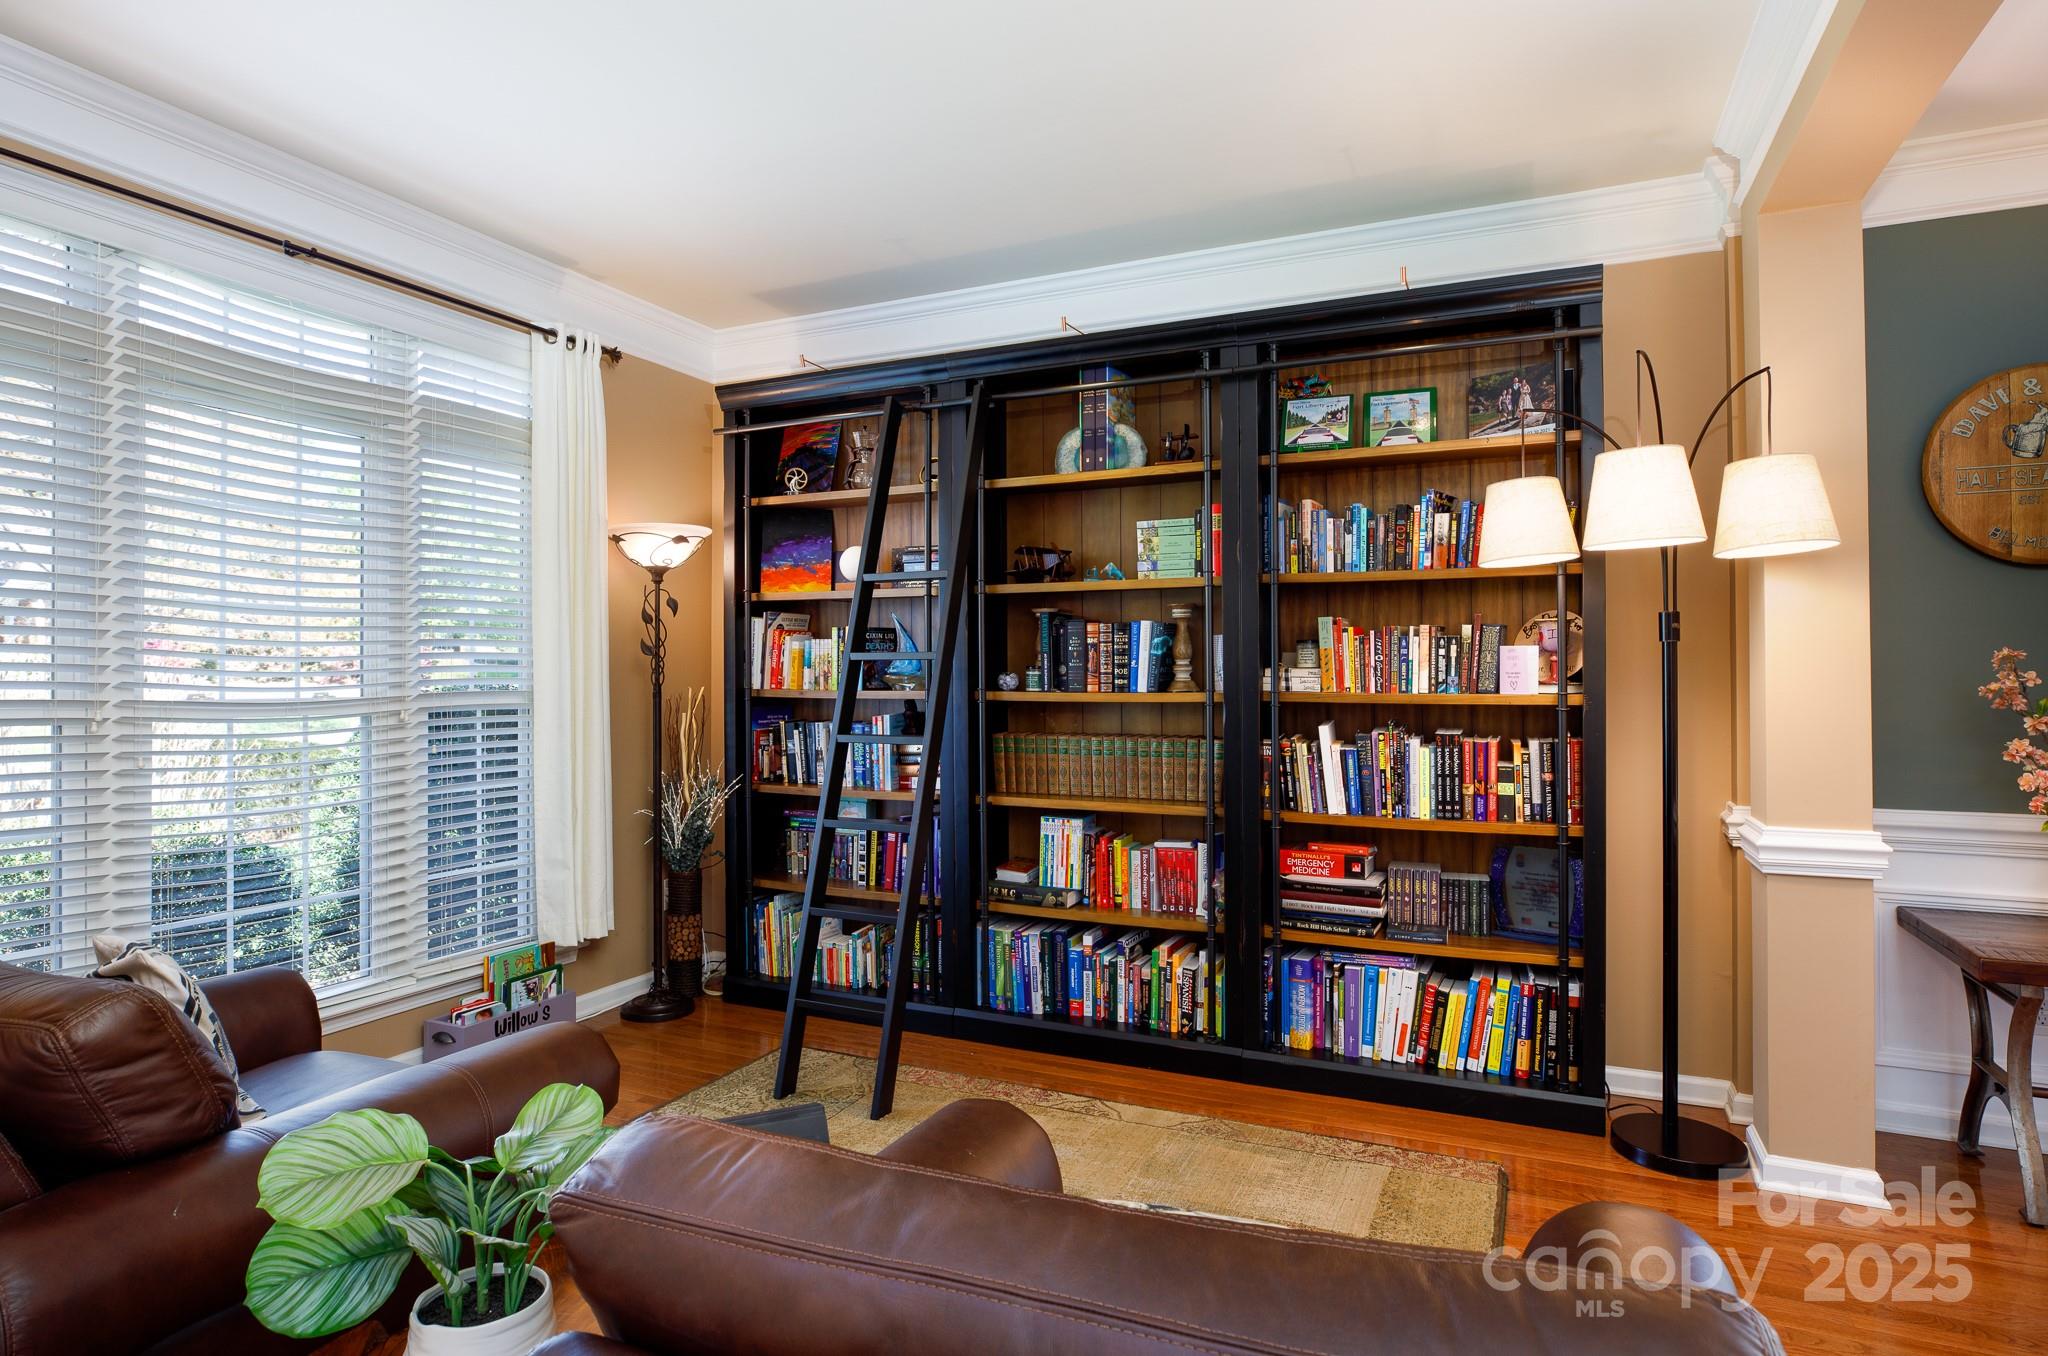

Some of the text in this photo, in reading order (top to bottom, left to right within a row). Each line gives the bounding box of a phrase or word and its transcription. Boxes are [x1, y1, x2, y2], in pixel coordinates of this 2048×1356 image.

[2023, 377, 2043, 396] &
[1956, 470, 2008, 490] HALF
[865, 632, 883, 640] CIXIN
[865, 642, 895, 651] DEATH'S
[1358, 741, 1366, 765] KING
[1378, 741, 1386, 769] WATCHMEN
[1545, 785, 1552, 793] AL
[1287, 857, 1335, 868] EMERGENCY
[1291, 852, 1331, 860] TINTINALLI'S
[1133, 863, 1141, 889] Sapiens
[1291, 866, 1331, 876] MEDICINE
[988, 887, 1016, 897] SMC
[1298, 984, 1306, 1009] MODERN
[494, 1003, 551, 1038] Willow's
[1473, 989, 1487, 1050] UNDERSTANDING NUTRITION
[1497, 1007, 1505, 1024] NUTRITION
